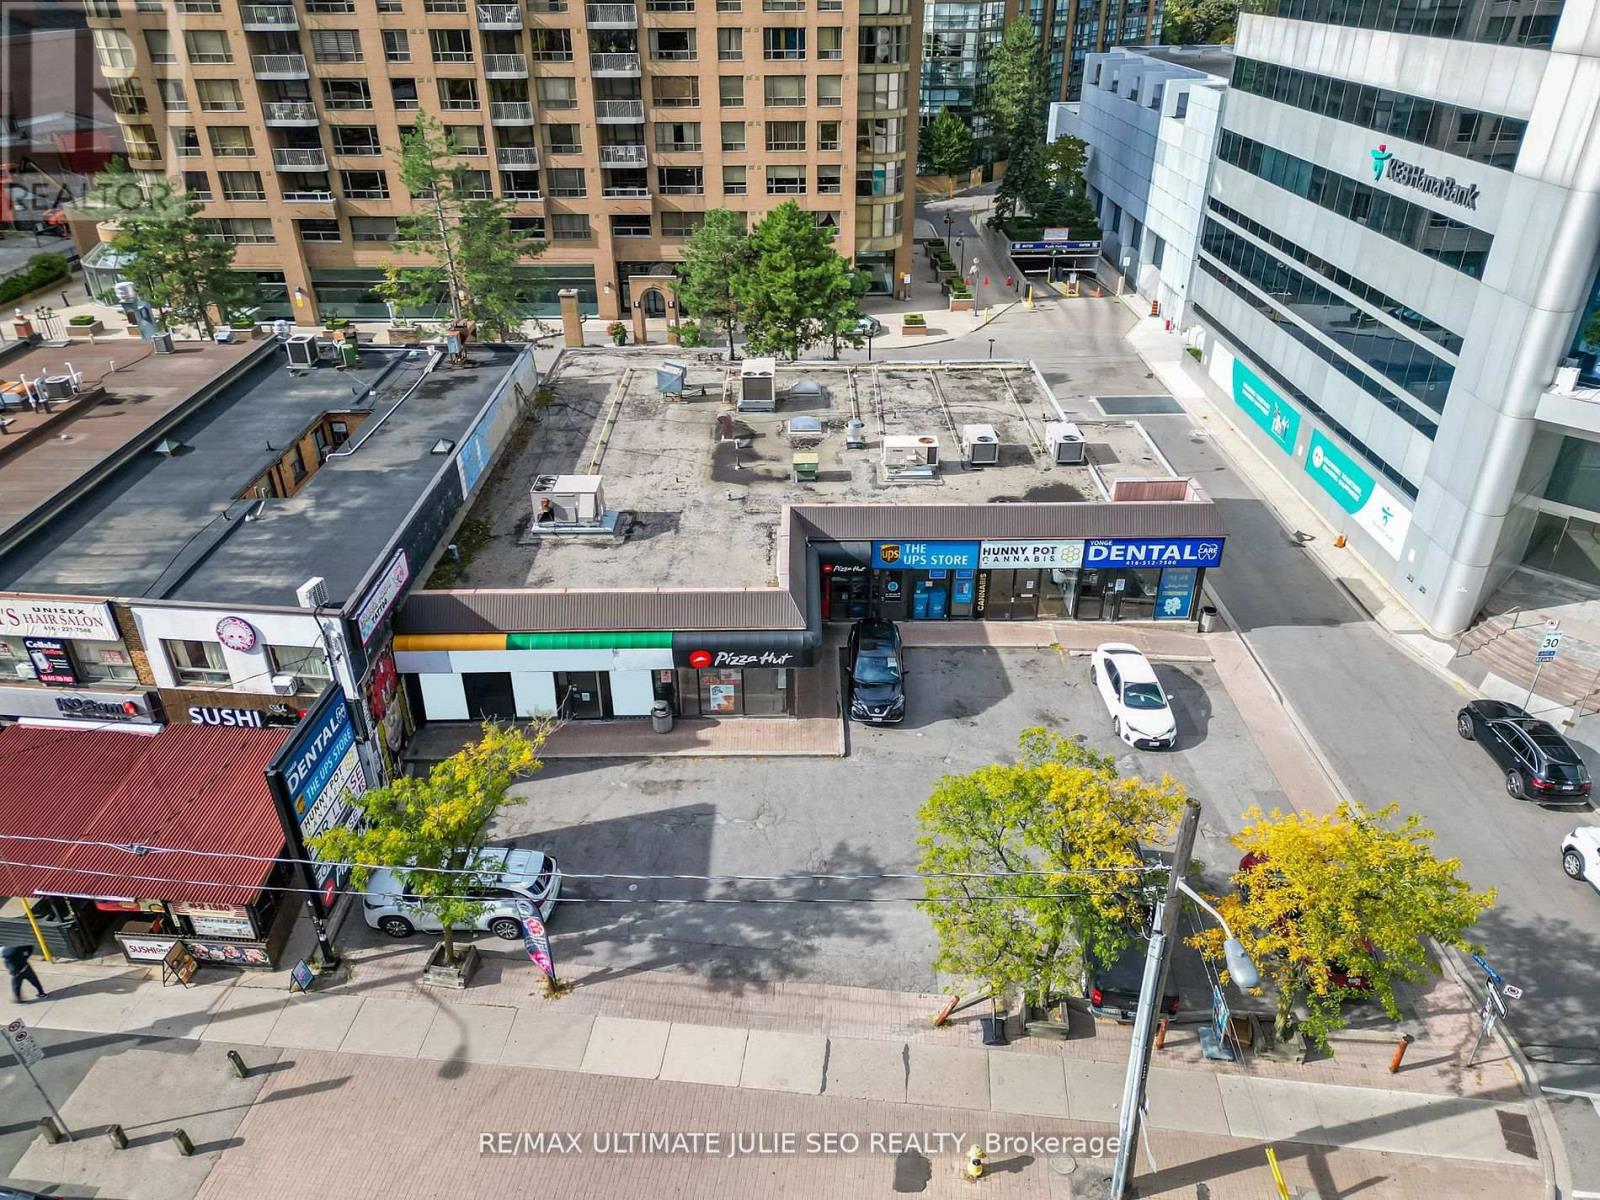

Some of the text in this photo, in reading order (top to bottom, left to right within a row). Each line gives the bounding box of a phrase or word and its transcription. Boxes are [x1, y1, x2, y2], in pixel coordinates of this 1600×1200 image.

[1441, 176, 1480, 211] Bank
[882, 550, 899, 561] ups
[905, 543, 927, 554] THE
[982, 546, 1057, 555] HUNNY POT
[1088, 545, 1197, 561] DENTAL
[903, 555, 968, 565] UPS STORE
[982, 556, 1055, 564] CANNABIS
[977, 573, 987, 611] CANNABIS
[32, 607, 85, 615] UNISEX
[23, 613, 58, 624] HAIR
[60, 614, 103, 627] SALON
[1543, 638, 1559, 648] 30
[714, 651, 793, 666] Pizza Hut
[187, 707, 262, 728] SUSHI
[287, 718, 340, 795] DENTAL
[306, 776, 320, 799] THE
[320, 756, 334, 780] UPS
[333, 728, 352, 759] STORE
[303, 766, 343, 829] HUNNY POT
[129, 944, 157, 955] SUSHI
